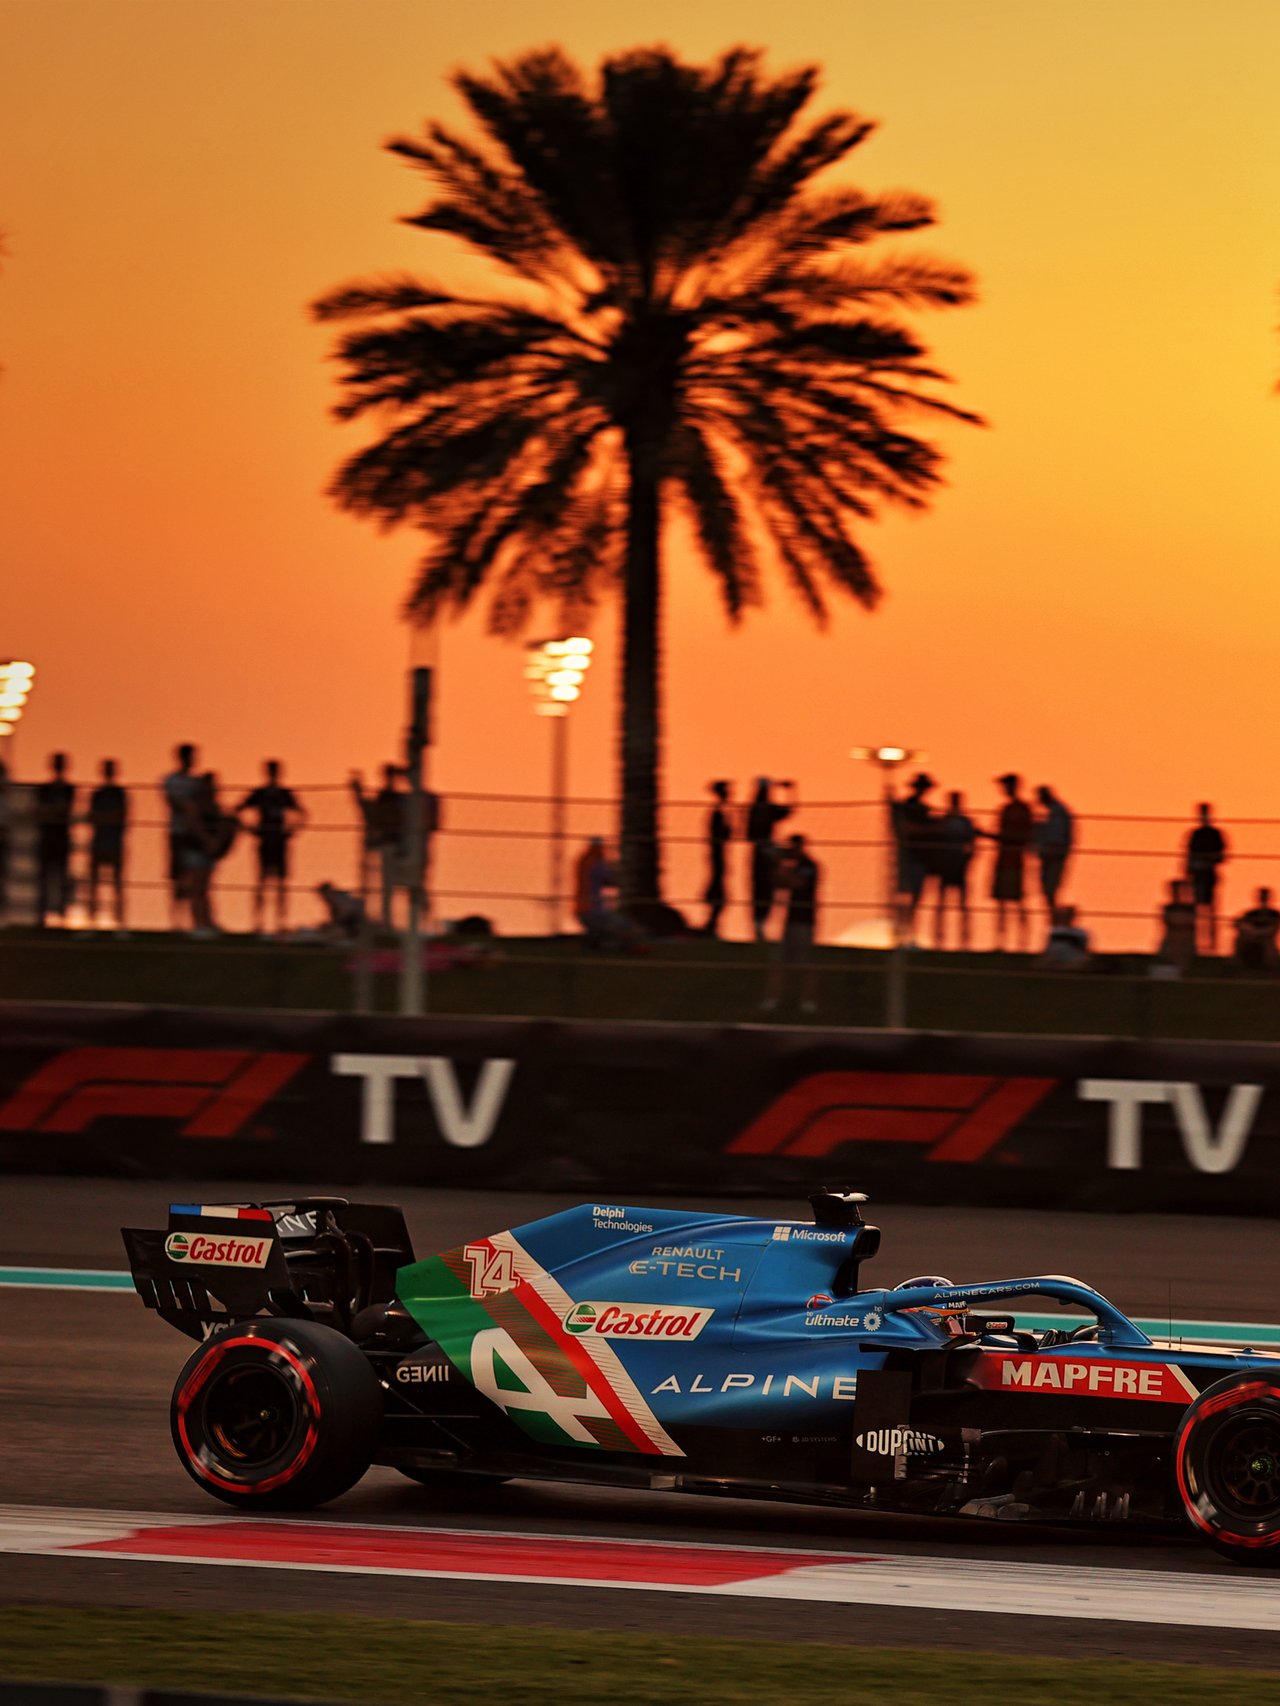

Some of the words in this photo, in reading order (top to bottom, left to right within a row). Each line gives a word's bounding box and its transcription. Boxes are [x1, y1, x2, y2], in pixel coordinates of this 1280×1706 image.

[331, 1053, 516, 1148] TV
[1077, 1078, 1264, 1173] TV
[593, 1206, 625, 1219] Delphi
[593, 1218, 653, 1233] Technologies
[792, 1229, 847, 1243] Microsoft
[189, 1237, 265, 1264] Castrol
[652, 1246, 725, 1261] RENAULT
[463, 1244, 520, 1298] 14
[628, 1260, 741, 1282] E-TECH
[934, 1282, 1041, 1299] ALPINECARS.COM
[595, 1306, 702, 1337] Castrol
[805, 1314, 860, 1327] ultimate
[651, 1374, 857, 1400] ALPINE
[1002, 1360, 1163, 1396] MAPFRE
[867, 1429, 937, 1456] DUPONT
